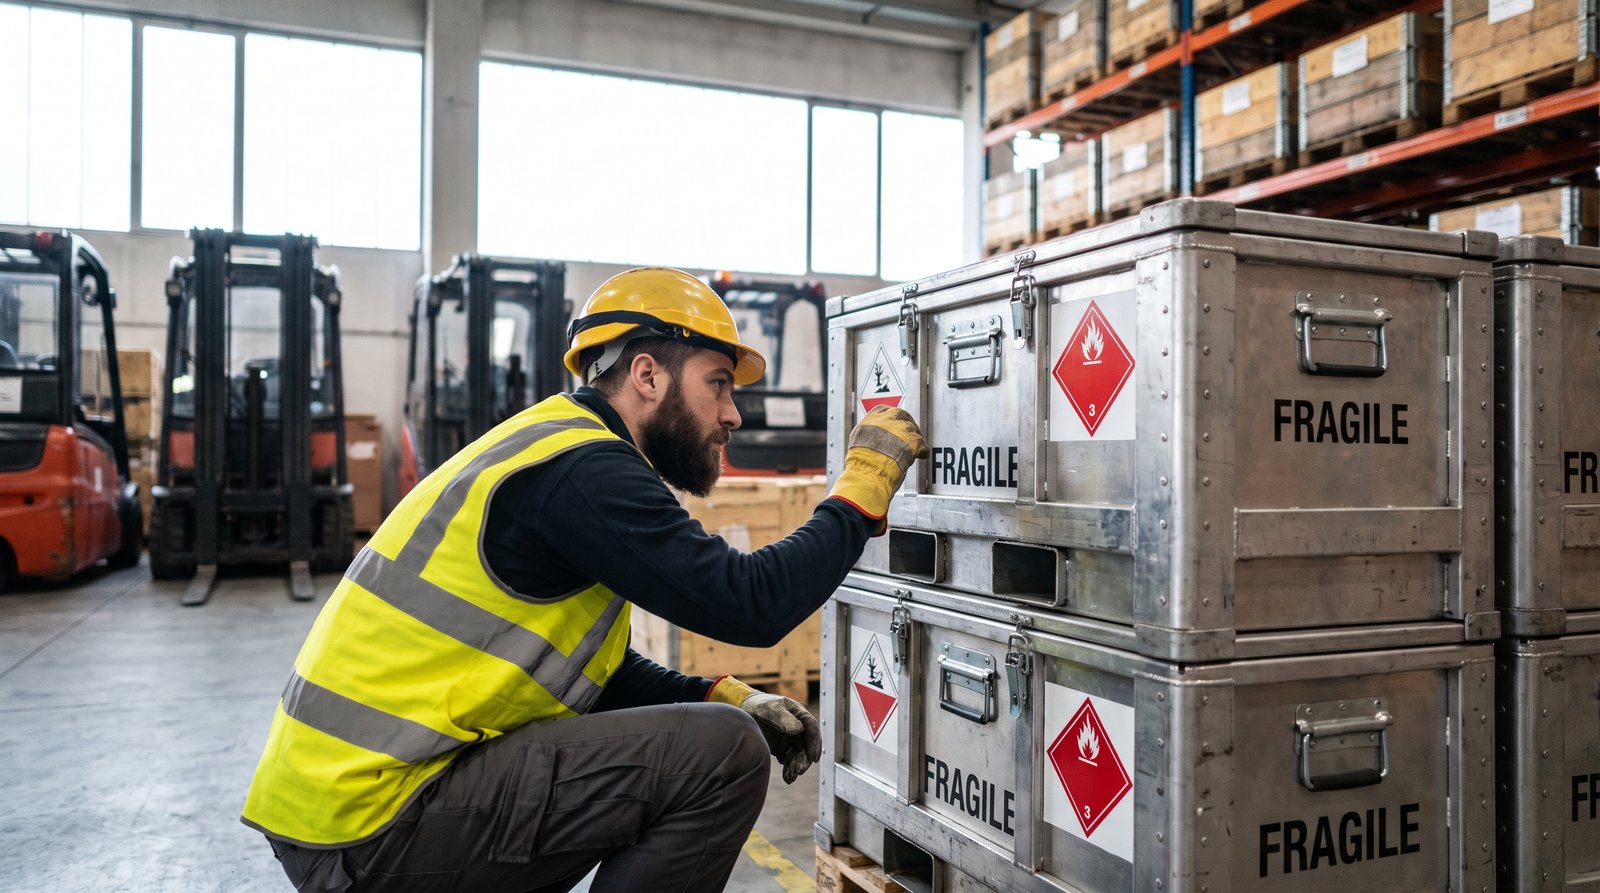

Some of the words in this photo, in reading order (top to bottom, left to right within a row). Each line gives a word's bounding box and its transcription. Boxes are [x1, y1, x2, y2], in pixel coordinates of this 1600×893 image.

[1088, 403, 1096, 417] 3
[1273, 399, 1409, 445] FRAGILE
[931, 446, 1018, 488] FRAGILE
[924, 753, 1015, 837] FRAGILE
[1083, 804, 1091, 820] 3
[1259, 803, 1421, 878] FRAGILE
